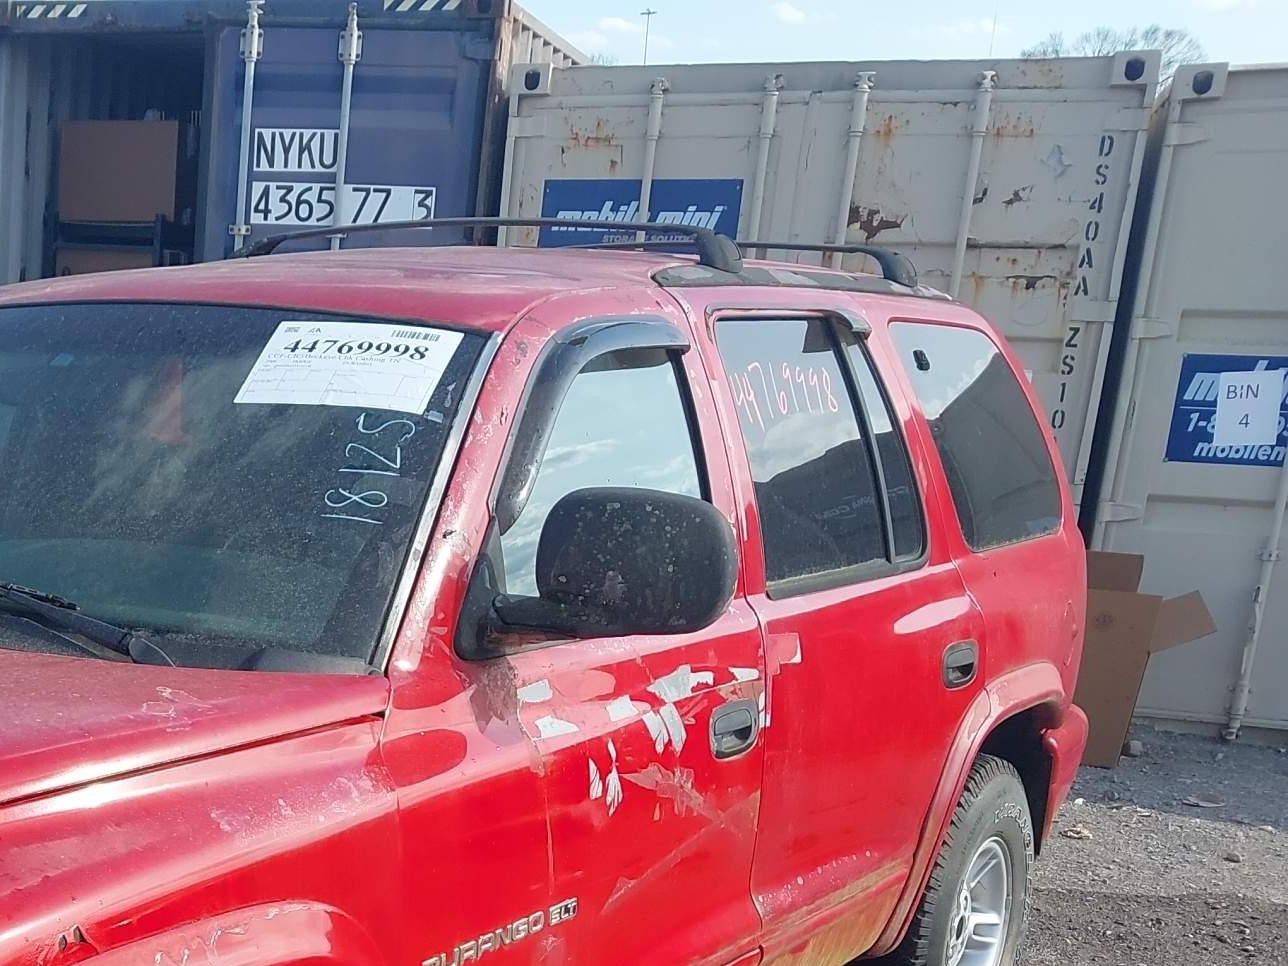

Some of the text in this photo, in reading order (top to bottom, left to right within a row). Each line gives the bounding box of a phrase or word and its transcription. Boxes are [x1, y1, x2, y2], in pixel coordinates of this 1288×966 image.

[255, 131, 340, 169] NYKU
[552, 201, 724, 232] mobil mini
[283, 338, 430, 361] 44769998
[729, 361, 839, 432] 44769998
[1226, 384, 1260, 399] BIN
[1238, 413, 1251, 429] 4
